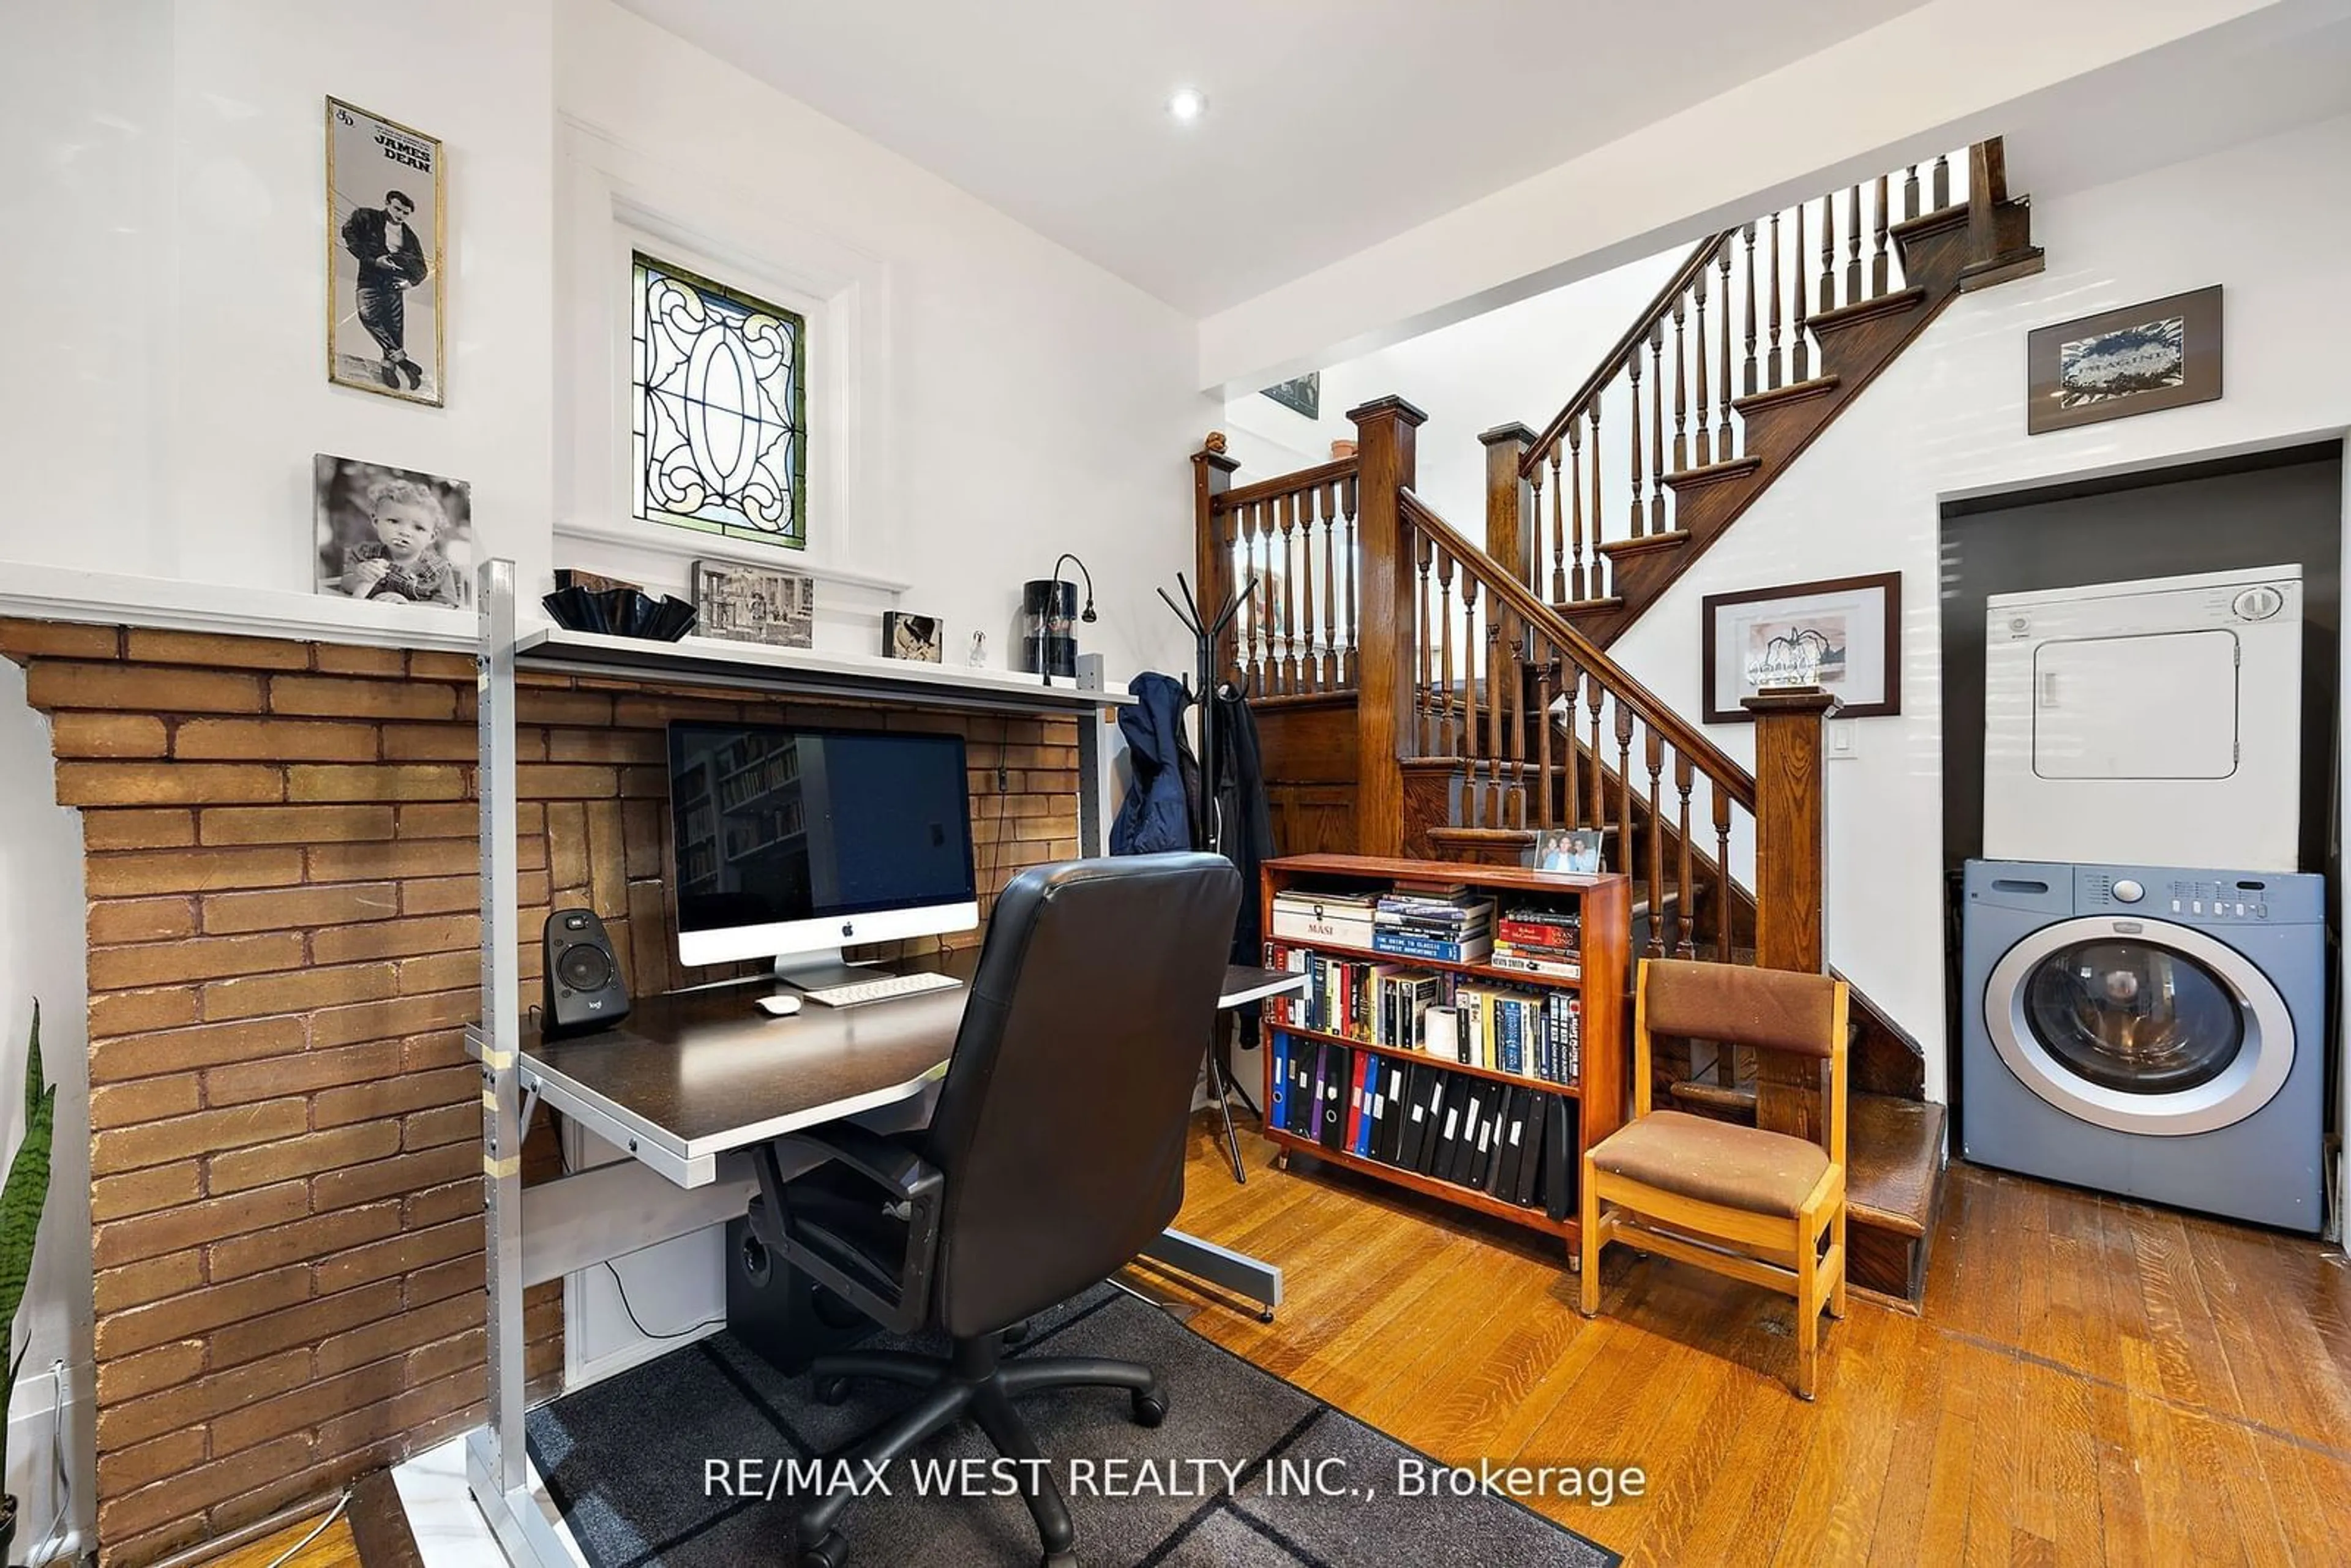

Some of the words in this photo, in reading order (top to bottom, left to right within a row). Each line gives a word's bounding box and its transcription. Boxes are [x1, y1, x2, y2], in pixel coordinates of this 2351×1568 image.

[374, 134, 431, 162] JAMES
[384, 148, 431, 173] DEAN
[1308, 924, 1333, 936] MASI
